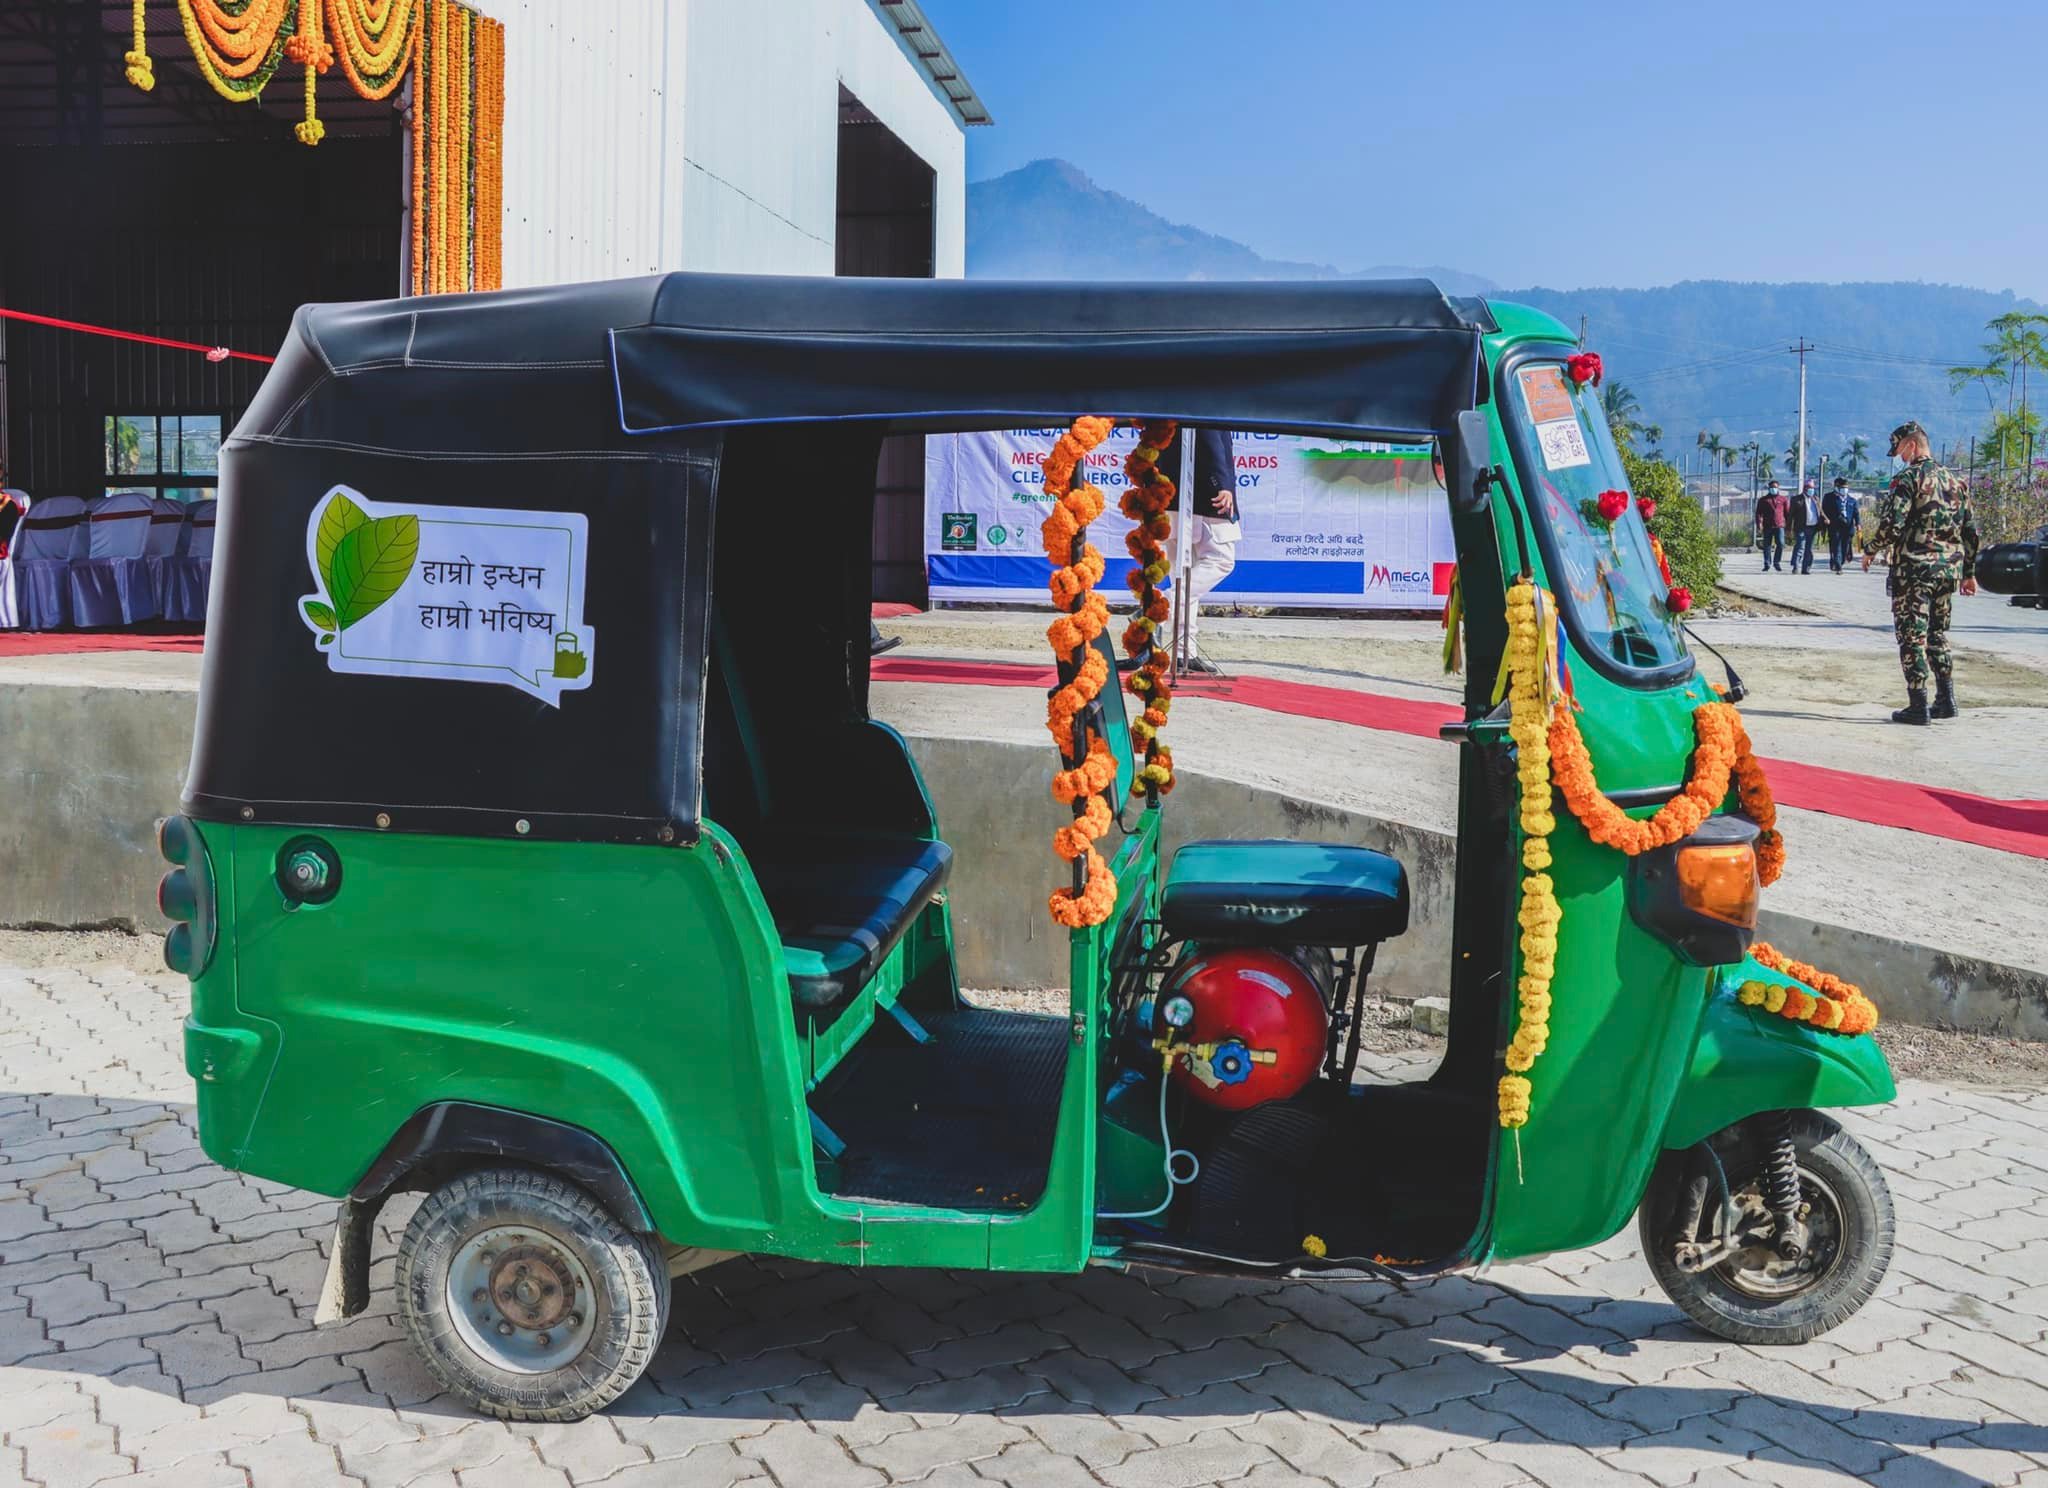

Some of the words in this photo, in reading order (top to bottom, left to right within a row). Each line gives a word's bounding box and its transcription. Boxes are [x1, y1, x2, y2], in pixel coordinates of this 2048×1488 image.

[1012, 452, 1047, 465] MEG
[420, 555, 475, 586] हाम्रो
[481, 563, 546, 590] इन्धन
[418, 600, 473, 632] हाम्रो
[479, 601, 557, 635] भविष्य
